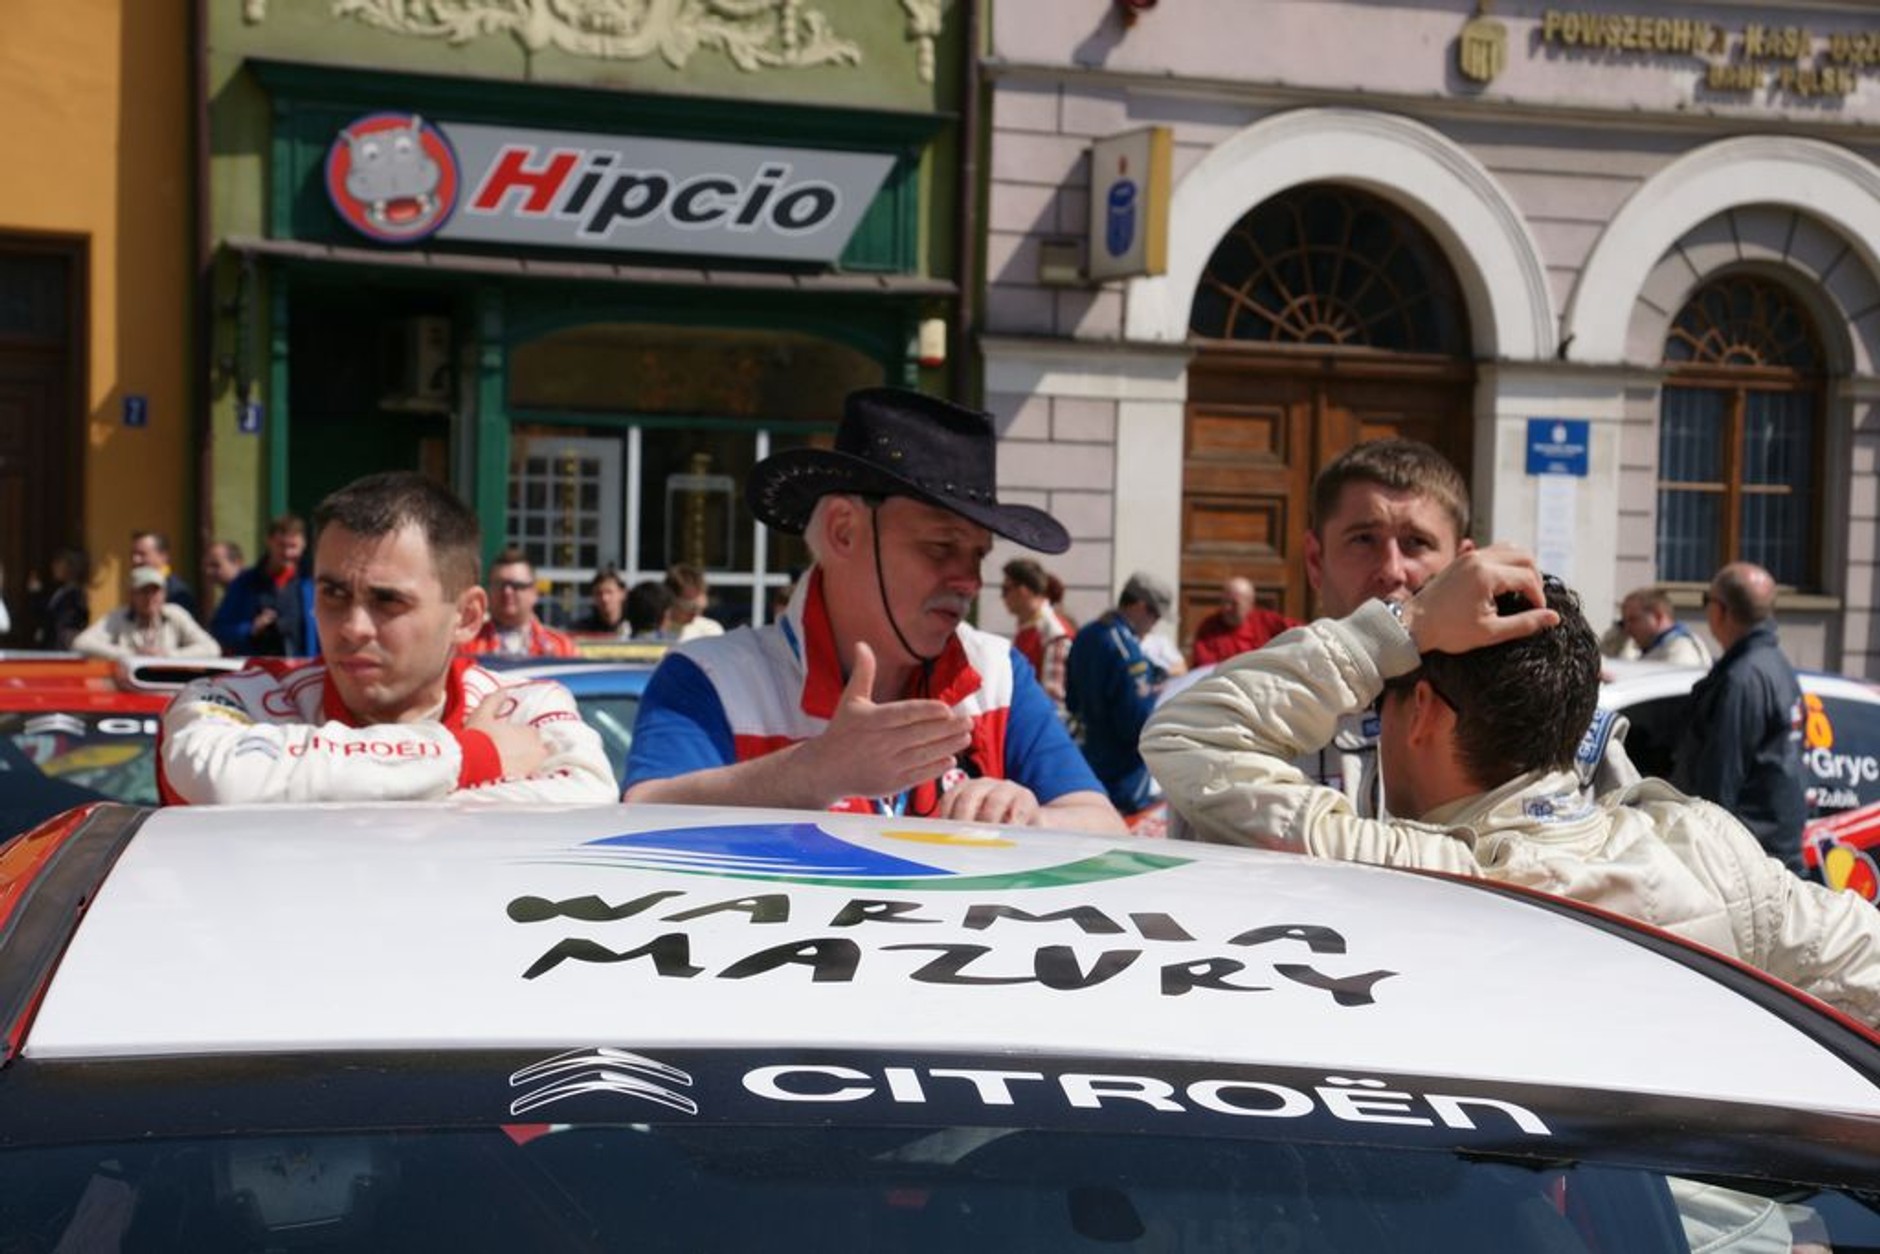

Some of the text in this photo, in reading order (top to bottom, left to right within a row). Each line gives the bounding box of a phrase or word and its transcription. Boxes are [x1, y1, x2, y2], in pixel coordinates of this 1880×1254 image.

[1542, 11, 1727, 54] POWSZECHNA
[471, 147, 837, 234] Hipcio
[506, 890, 1346, 953] WARMIA
[521, 932, 1400, 1007] MAZURY
